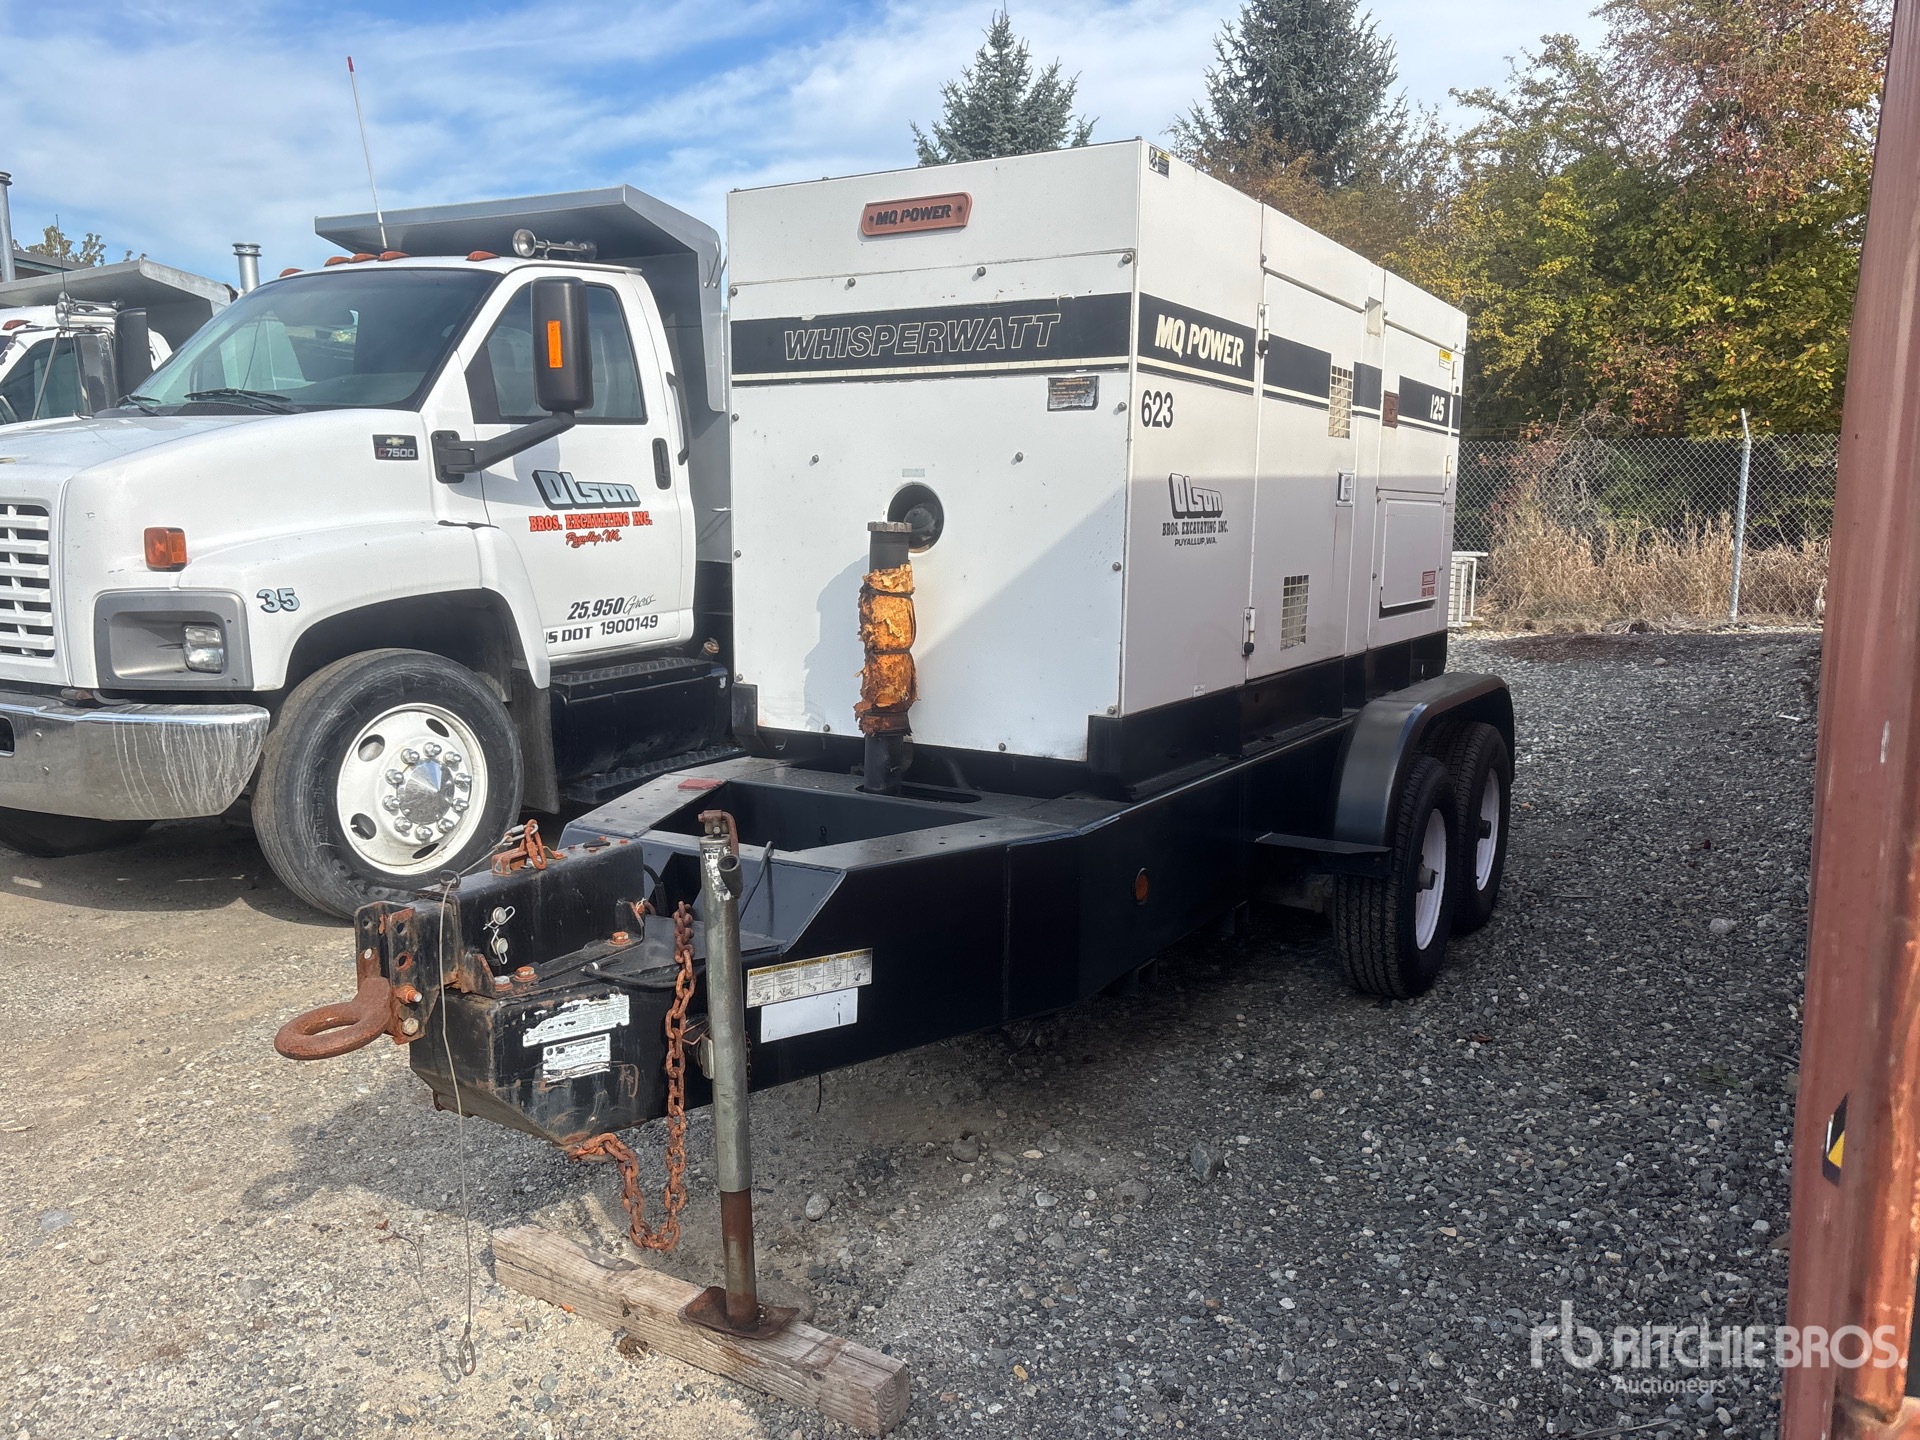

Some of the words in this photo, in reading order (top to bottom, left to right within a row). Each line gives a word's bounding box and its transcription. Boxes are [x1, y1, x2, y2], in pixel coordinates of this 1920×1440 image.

[875, 209, 898, 226] MQ
[900, 204, 952, 223] POWER
[784, 313, 1061, 360] WHISPERWATT
[1154, 314, 1186, 358] MQ
[1186, 323, 1244, 367] POWER
[1141, 389, 1174, 428] 623
[1430, 394, 1446, 422] 125
[377, 447, 416, 458] C7500
[528, 515, 563, 532] BROS.
[564, 512, 631, 530] EXCAVATING
[632, 511, 653, 527] INC.
[1162, 522, 1180, 536] BROS.
[1181, 520, 1217, 535] EXCAVATING
[1218, 520, 1229, 533] INC.
[256, 587, 300, 613] 35
[566, 597, 625, 621] 25,950
[561, 626, 593, 642] DOT
[600, 615, 659, 635] 1900149
